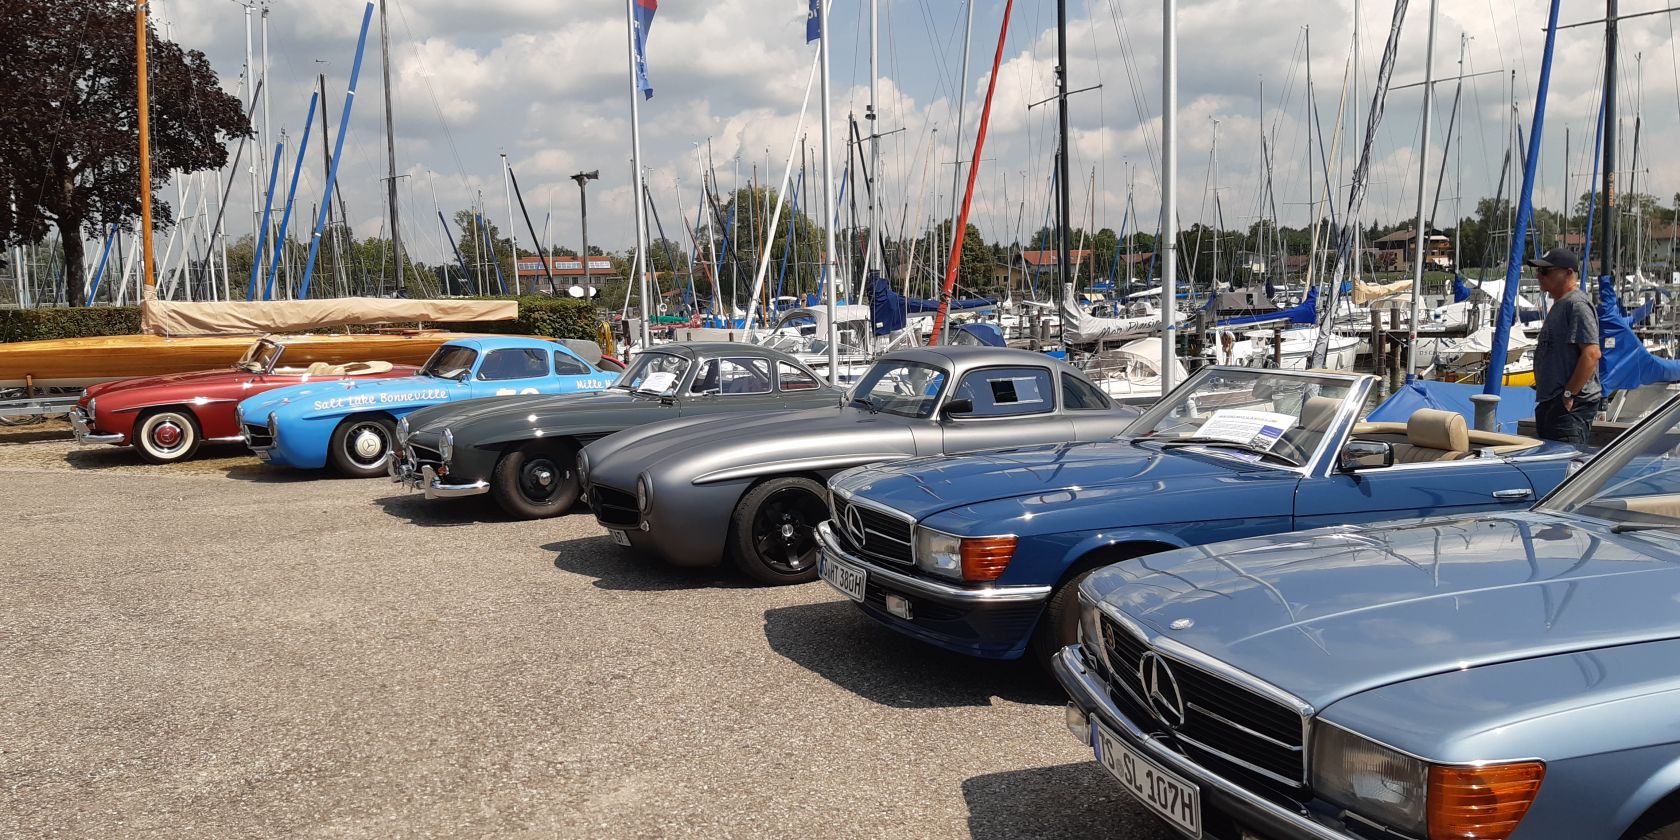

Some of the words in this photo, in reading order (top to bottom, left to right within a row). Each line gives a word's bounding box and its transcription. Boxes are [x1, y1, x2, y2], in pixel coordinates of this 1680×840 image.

[576, 379, 605, 390] Mille
[314, 397, 344, 411] Salt
[348, 394, 377, 407] Lake
[380, 388, 449, 403] Bonneville
[840, 567, 862, 596] 380H
[1099, 730, 1115, 770] TS
[1123, 752, 1143, 794] SL
[1146, 769, 1194, 827] 107H
